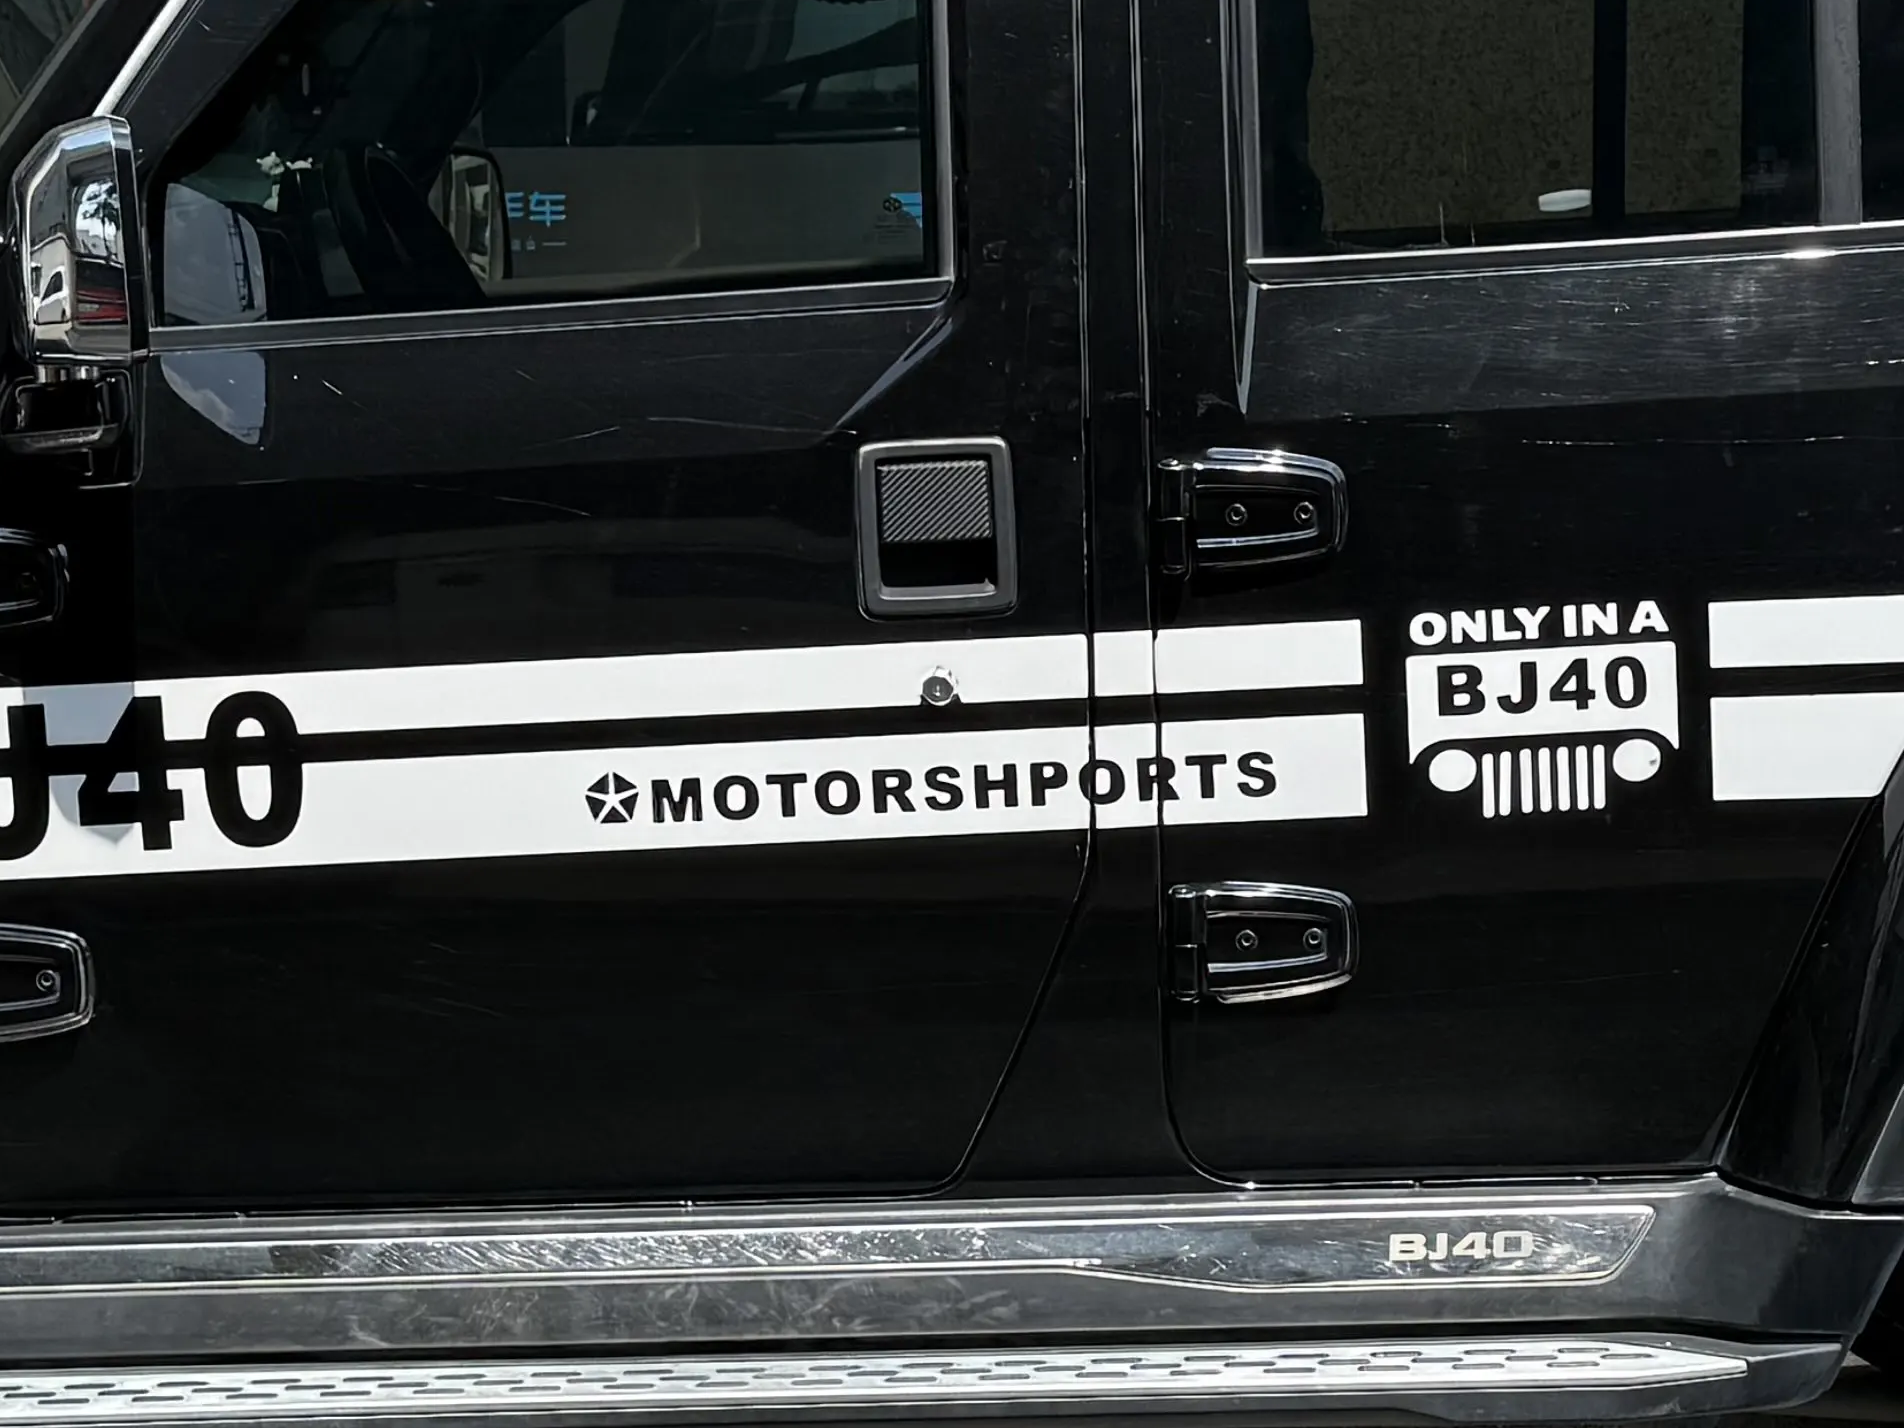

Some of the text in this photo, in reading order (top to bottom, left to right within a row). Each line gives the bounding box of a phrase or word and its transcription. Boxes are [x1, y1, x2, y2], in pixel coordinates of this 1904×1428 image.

[1408, 599, 1670, 646] ONLY IN A
[1436, 655, 1648, 717] BJ40
[651, 750, 1278, 824] MOTORSHPORTS
[1388, 1230, 1534, 1262] BJ40
